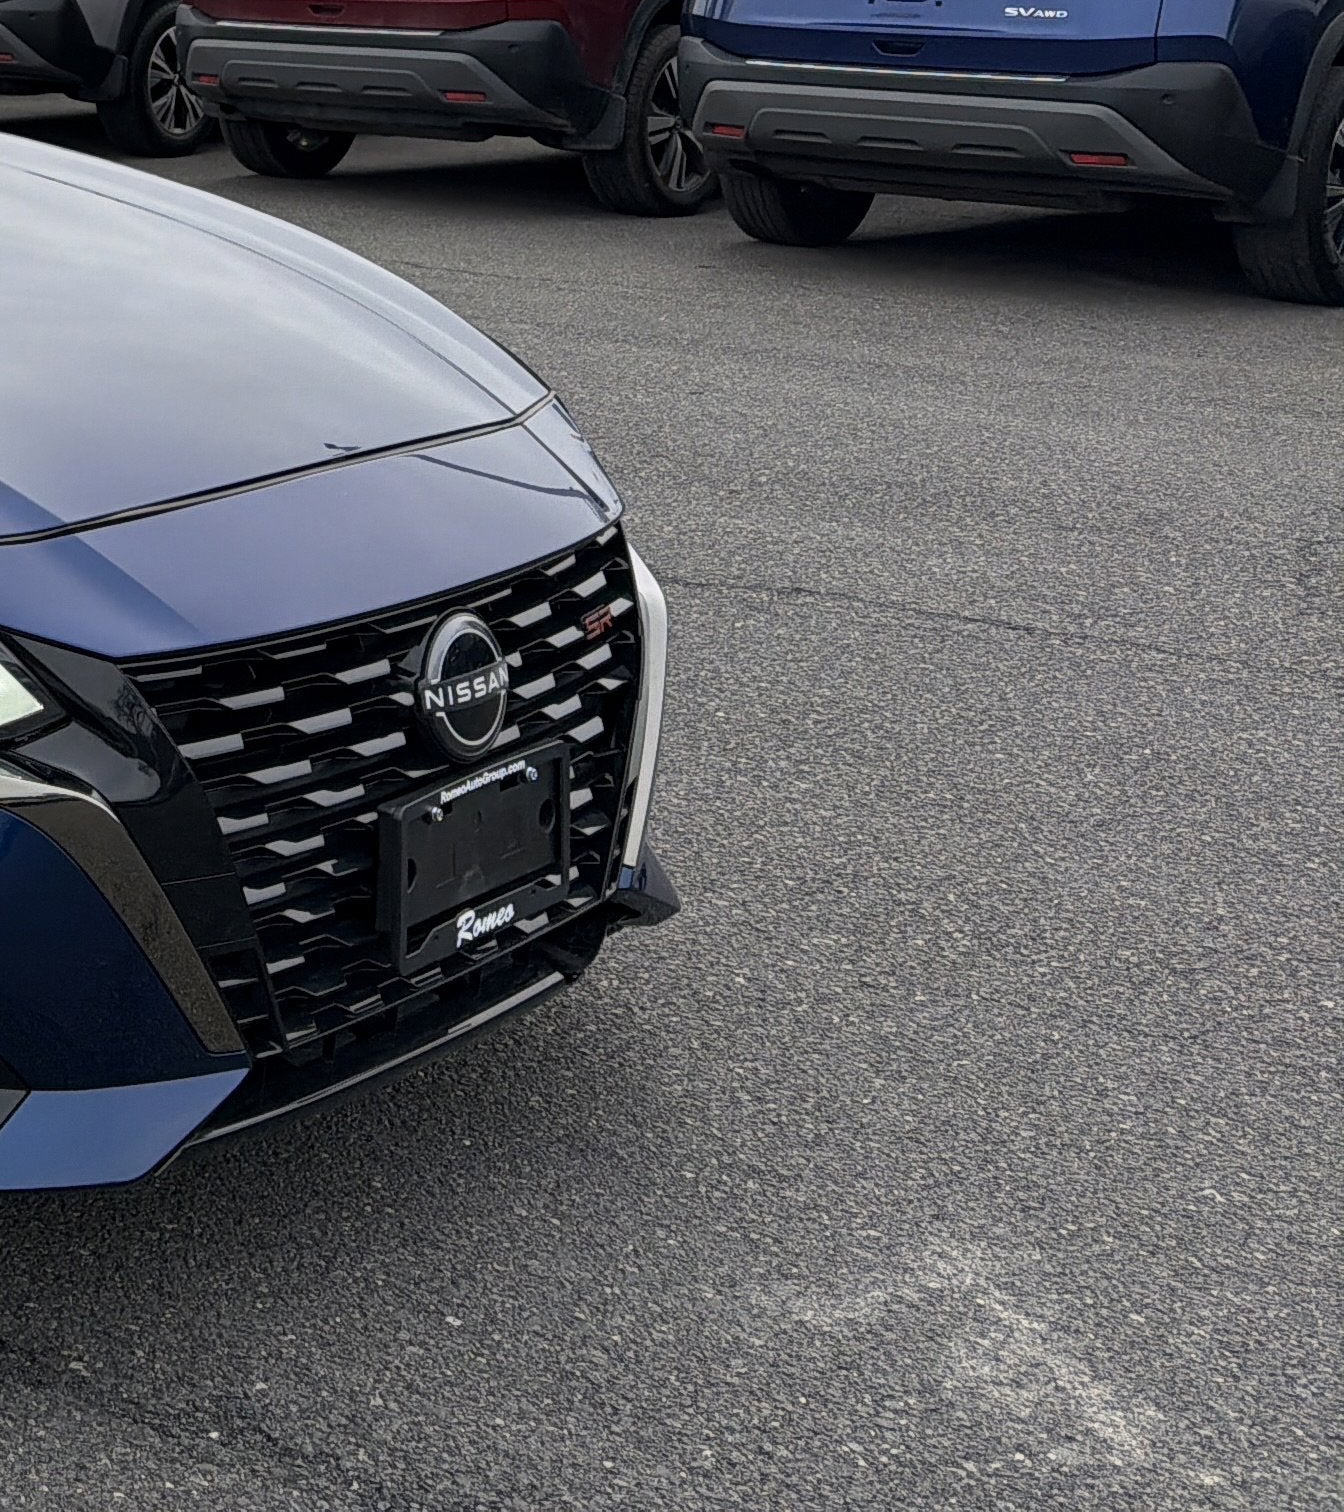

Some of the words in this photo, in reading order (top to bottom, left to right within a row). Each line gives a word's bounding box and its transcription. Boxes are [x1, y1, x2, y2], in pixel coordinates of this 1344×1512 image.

[583, 605, 613, 640] SR
[424, 665, 509, 709] NISSAN
[440, 759, 526, 805] RomeoAutoGroup.com
[456, 903, 515, 949] Romeo
